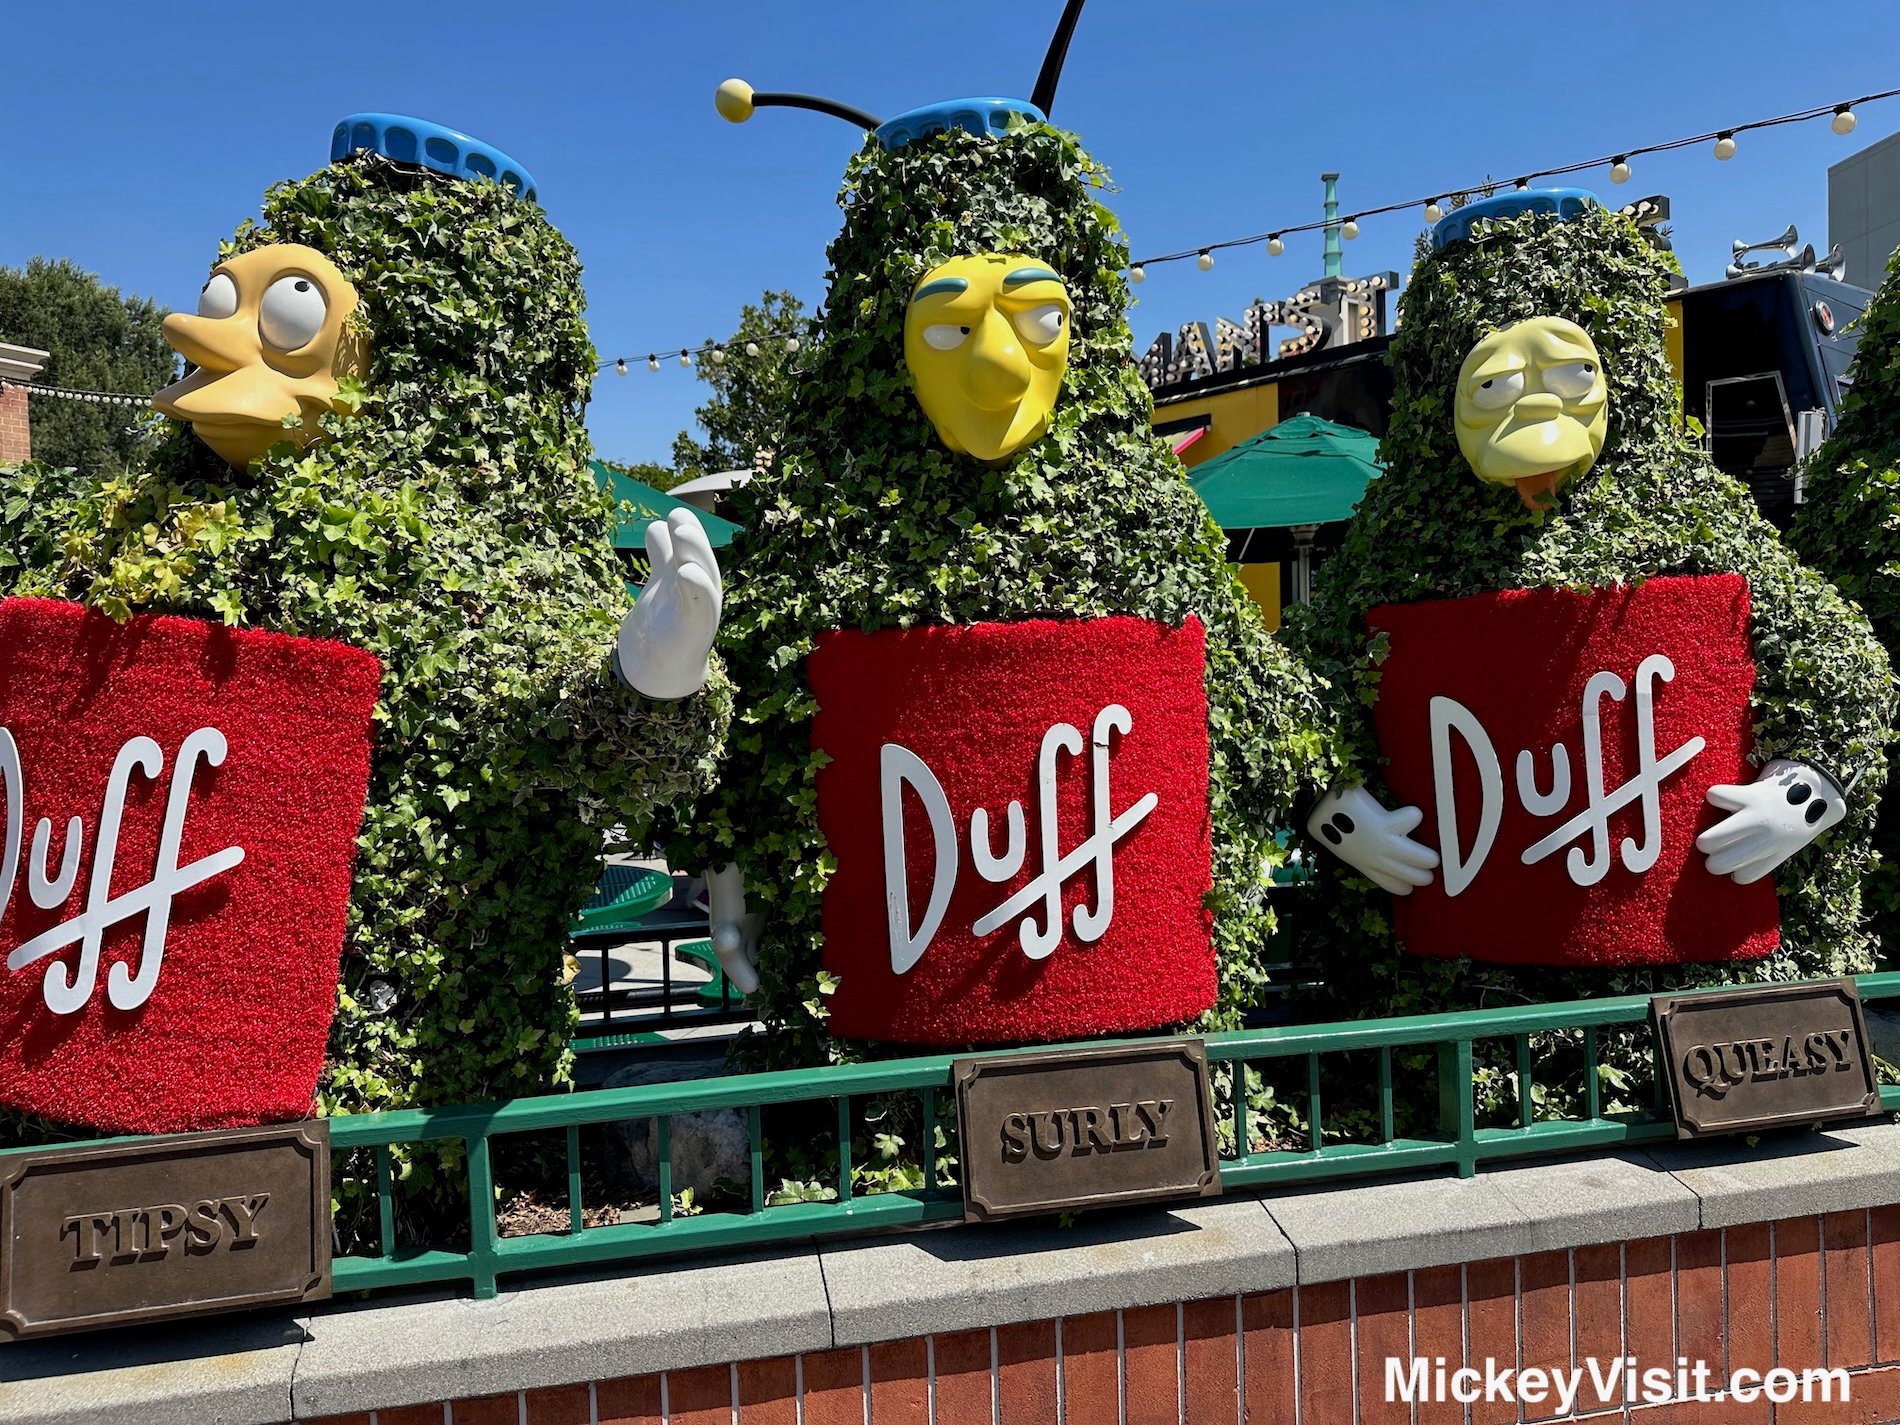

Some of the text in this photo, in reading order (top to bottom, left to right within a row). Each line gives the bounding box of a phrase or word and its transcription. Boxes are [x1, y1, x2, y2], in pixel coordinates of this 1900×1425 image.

[1429, 653, 1706, 898] Duff
[880, 703, 1159, 975] Duff
[1682, 1028, 1855, 1101] QUEASY
[1000, 1099, 1175, 1164] SURLY
[59, 1191, 272, 1273] TIPSY
